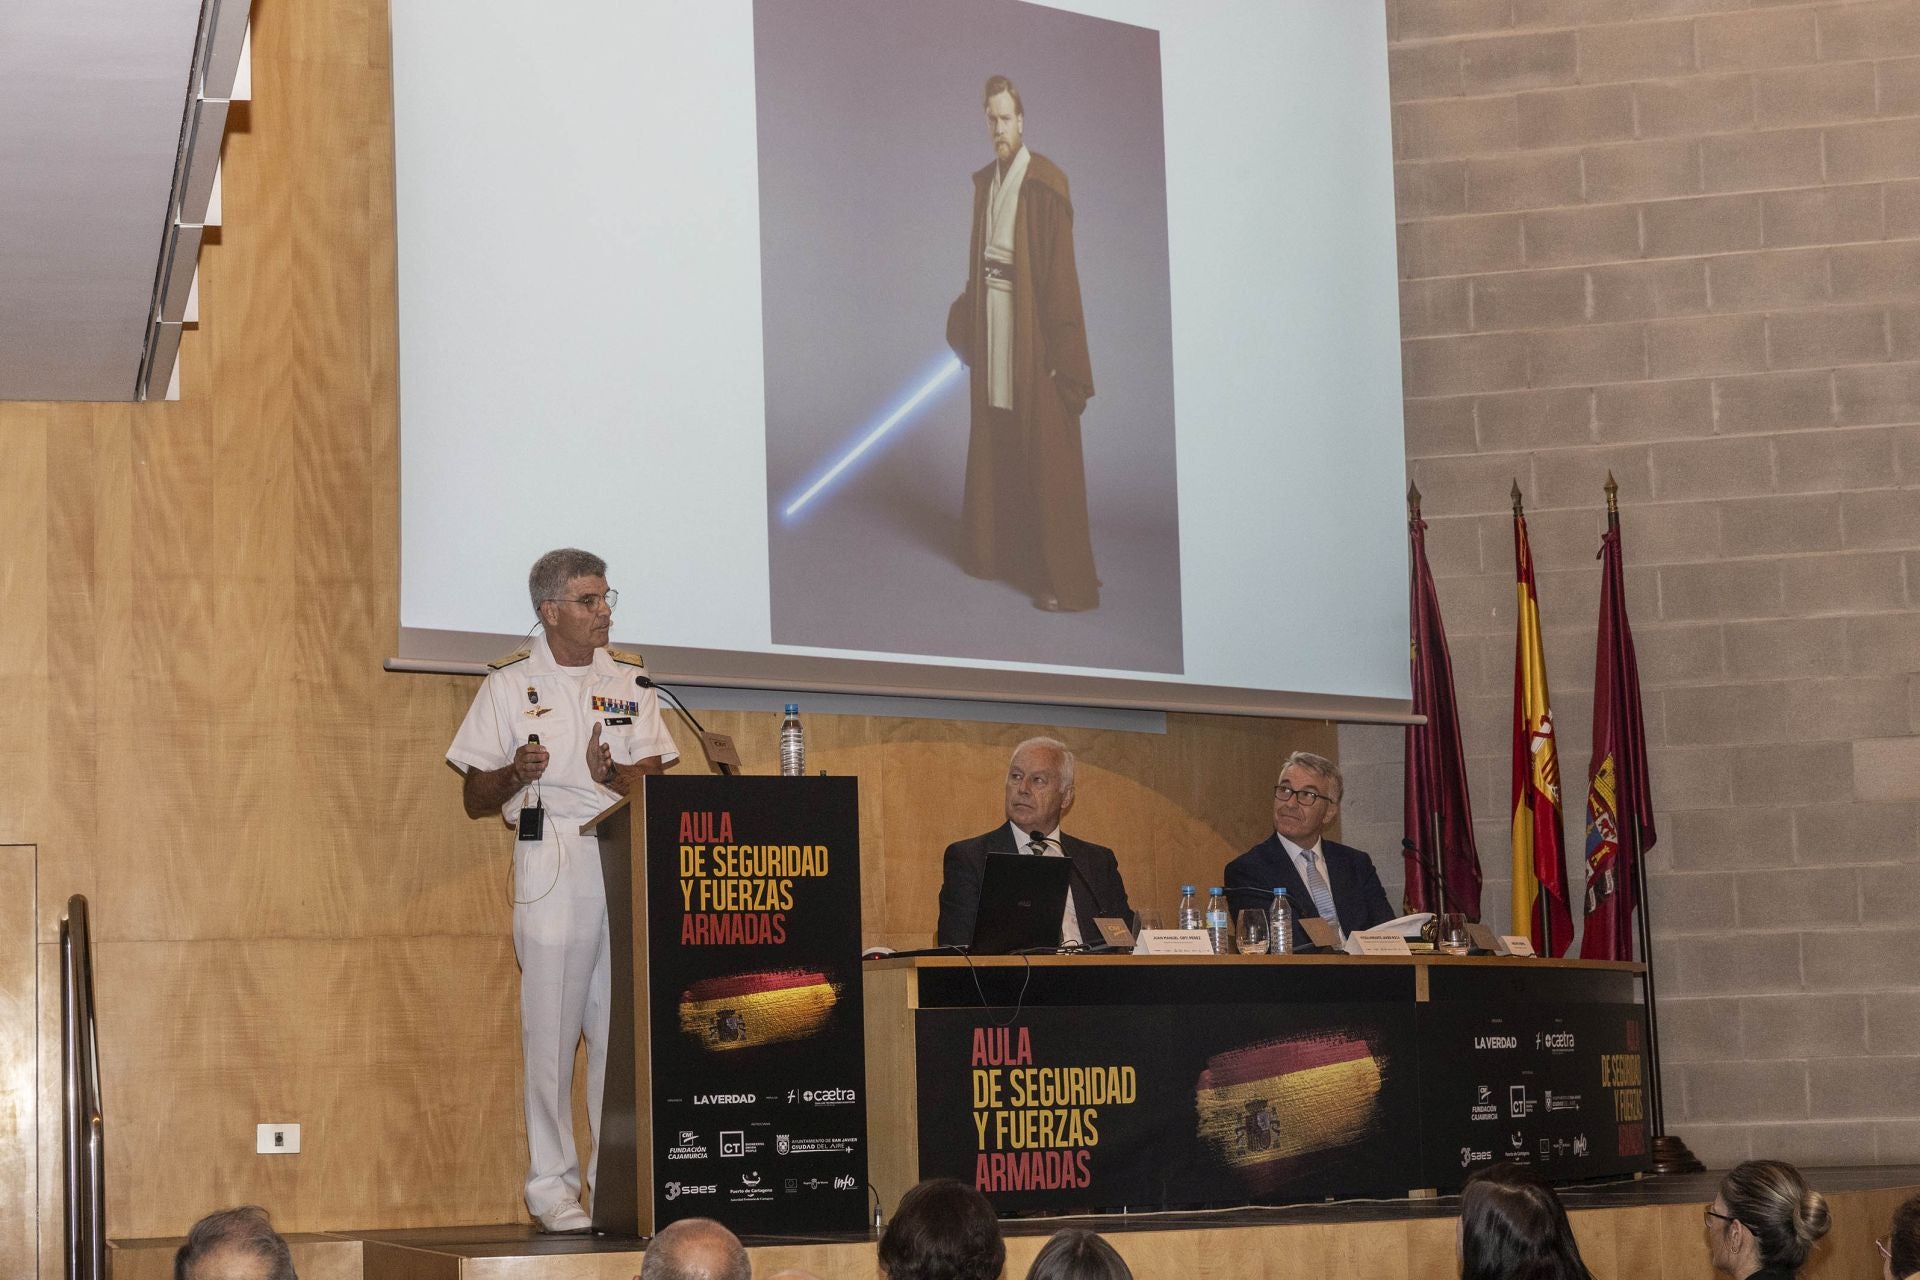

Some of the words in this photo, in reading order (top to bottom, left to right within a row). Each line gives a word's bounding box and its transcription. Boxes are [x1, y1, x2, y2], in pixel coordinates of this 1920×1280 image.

[680, 812, 733, 842] AULA
[680, 846, 706, 877] DE
[713, 846, 828, 877] SEGURIDAD
[680, 880, 694, 911] Y
[701, 880, 794, 911] FUERZAS
[681, 913, 786, 945] ARMADAS
[972, 1027, 1032, 1066] AULA
[1486, 1036, 1517, 1049] VERDAD
[1601, 1054, 1611, 1087] DE
[694, 1095, 710, 1104] LA
[710, 1094, 756, 1104] VERDAD
[973, 1069, 1002, 1108] DE
[1010, 1066, 1136, 1107] SEGURIDAD
[1513, 1101, 1523, 1113] CT
[973, 1112, 989, 1150] Y
[996, 1108, 1098, 1150] FUERZAS
[724, 1143, 740, 1153] CT
[834, 1174, 855, 1190] info
[975, 1150, 1091, 1192] ARMADAS
[682, 1185, 717, 1194] saes
